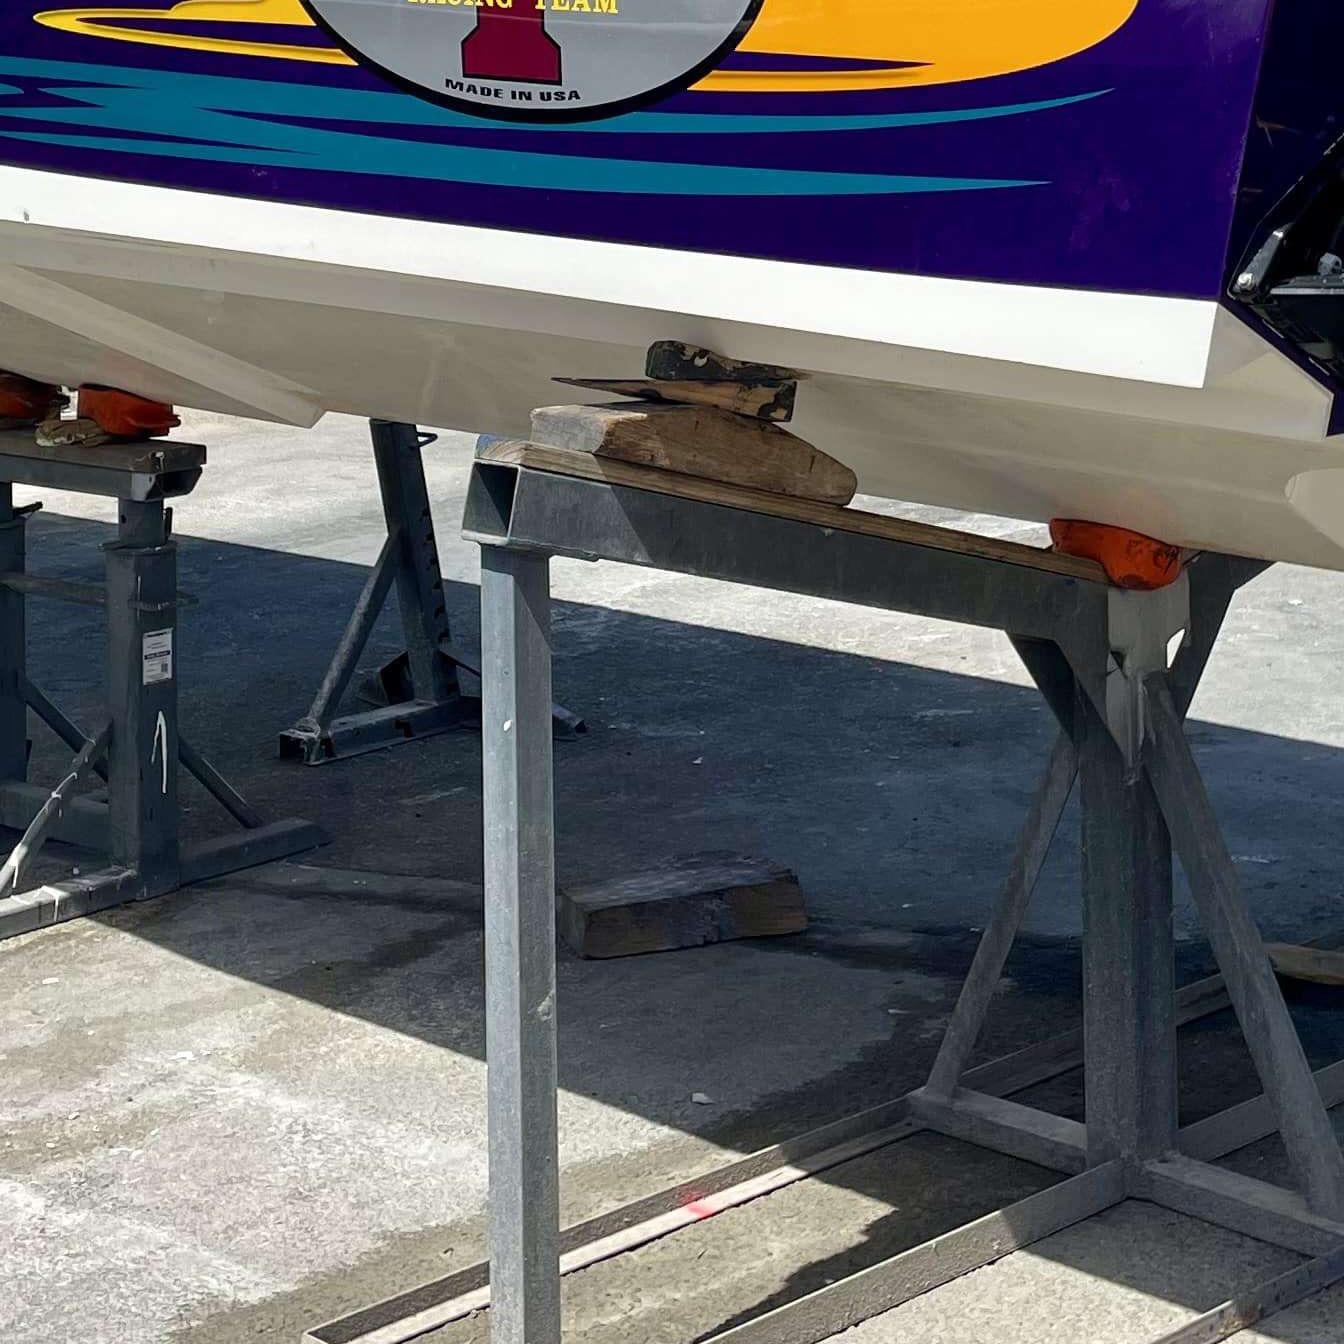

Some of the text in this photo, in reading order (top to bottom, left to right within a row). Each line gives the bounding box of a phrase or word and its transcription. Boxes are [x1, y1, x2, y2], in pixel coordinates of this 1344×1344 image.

[445, 78, 581, 102] MADE IN USA
